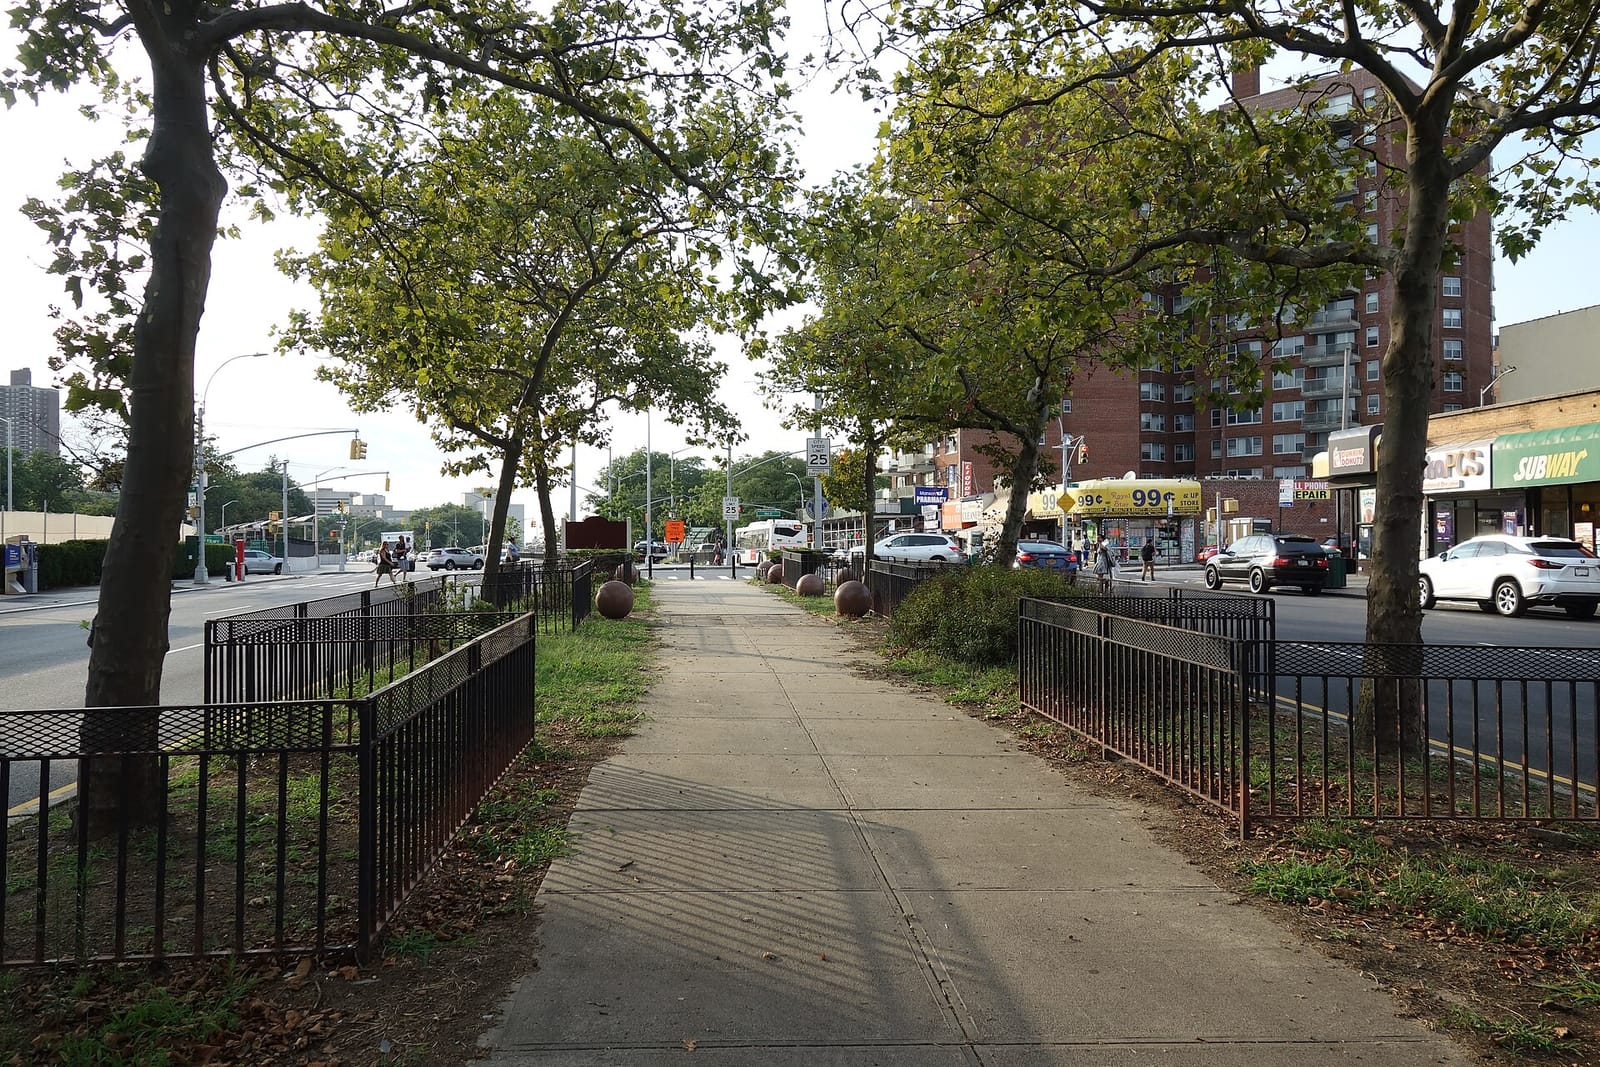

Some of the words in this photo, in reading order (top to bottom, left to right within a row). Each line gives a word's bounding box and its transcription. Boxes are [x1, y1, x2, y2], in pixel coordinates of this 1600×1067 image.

[809, 454, 828, 465] 25
[1513, 448, 1588, 481] SUBWAY
[1304, 481, 1329, 490] PHONE
[1042, 494, 1057, 511] 99
[725, 506, 737, 514] 25
